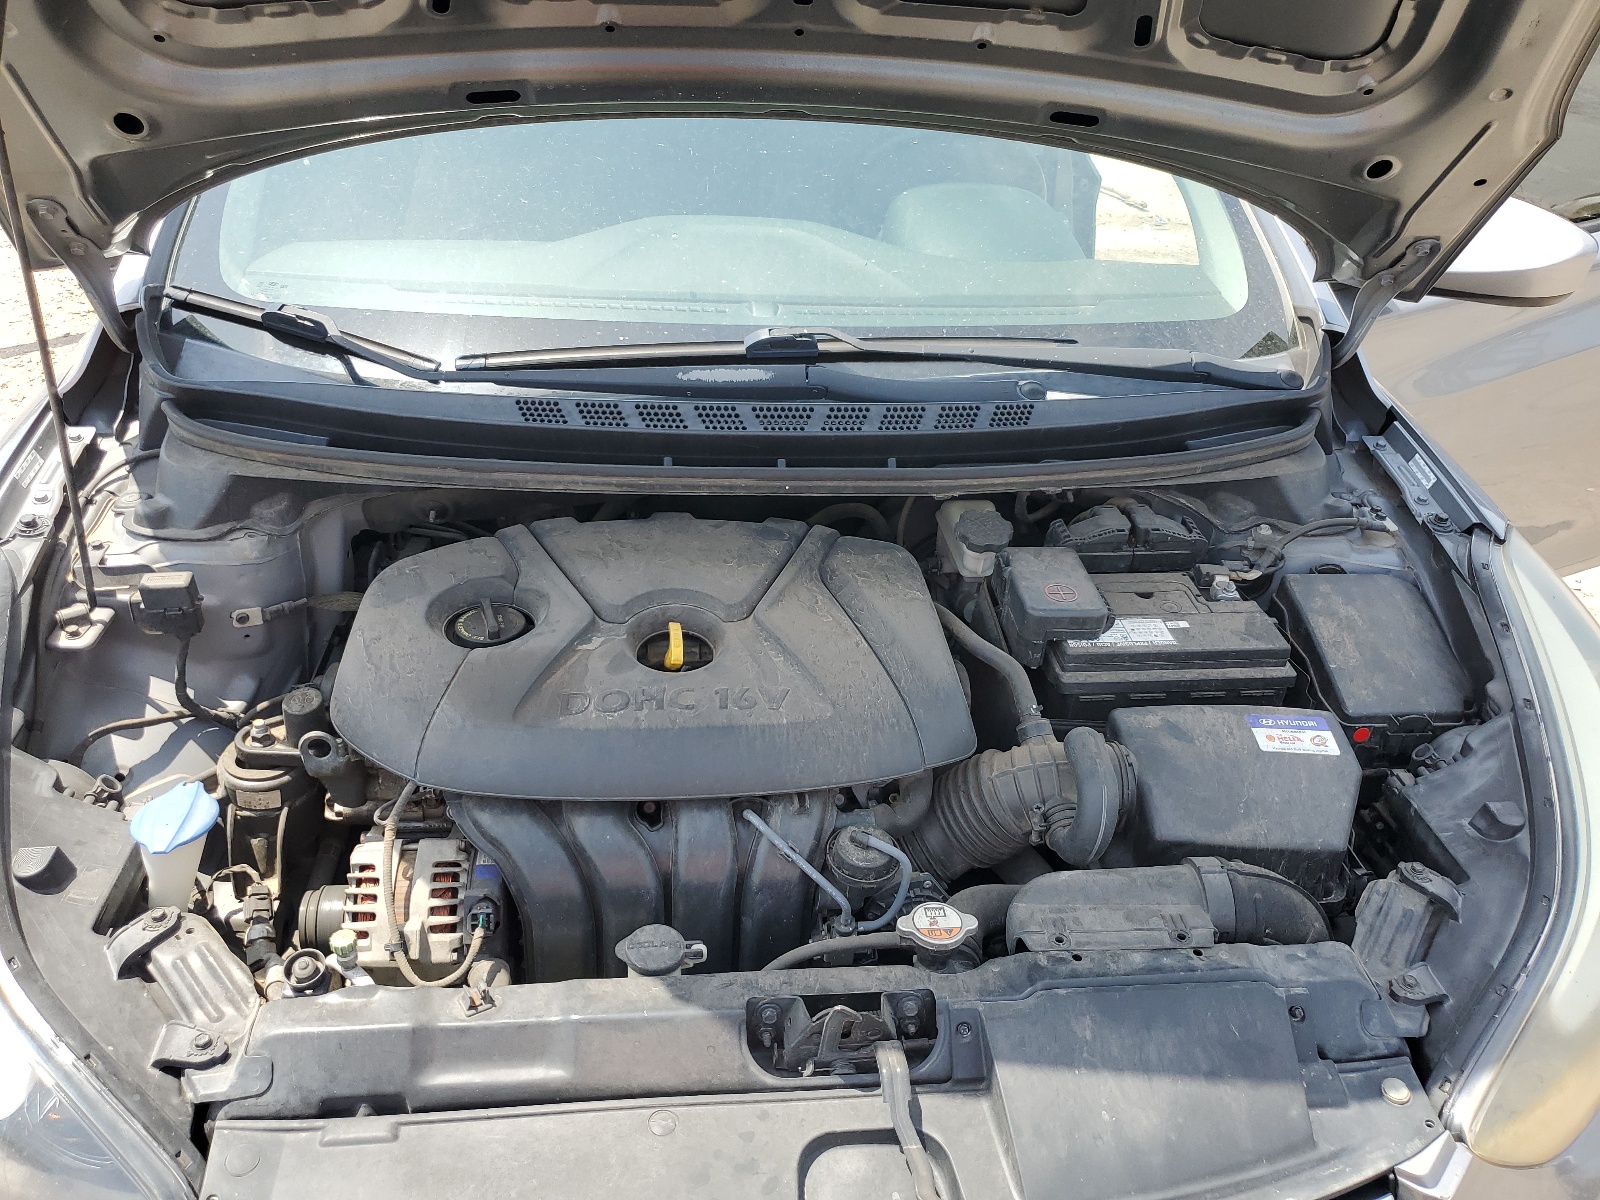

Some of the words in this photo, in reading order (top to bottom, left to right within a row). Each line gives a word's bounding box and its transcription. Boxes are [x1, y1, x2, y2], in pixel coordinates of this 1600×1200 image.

[557, 686, 696, 718] DOHC
[714, 686, 791, 711] 16V
[1276, 719, 1318, 727] HYUNDAI
